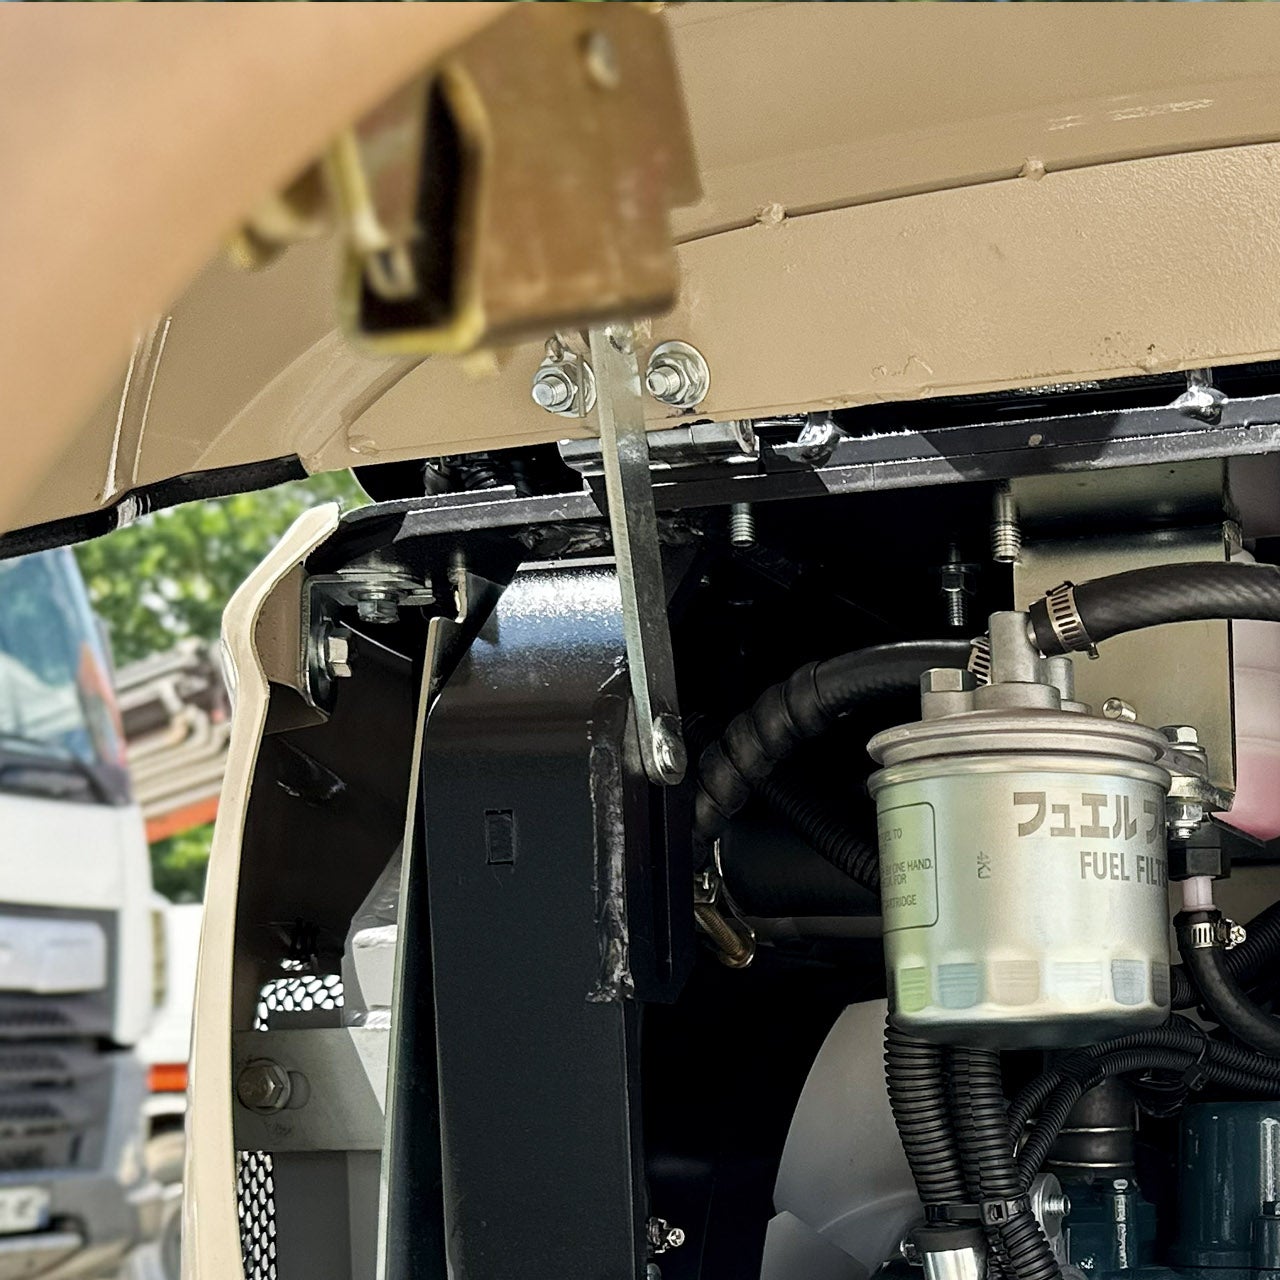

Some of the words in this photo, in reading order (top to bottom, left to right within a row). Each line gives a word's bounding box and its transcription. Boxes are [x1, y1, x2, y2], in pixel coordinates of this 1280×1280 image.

[1013, 791, 1137, 841] フュエル
[907, 858, 934, 872] HAND.
[1080, 851, 1130, 881] FUEL
